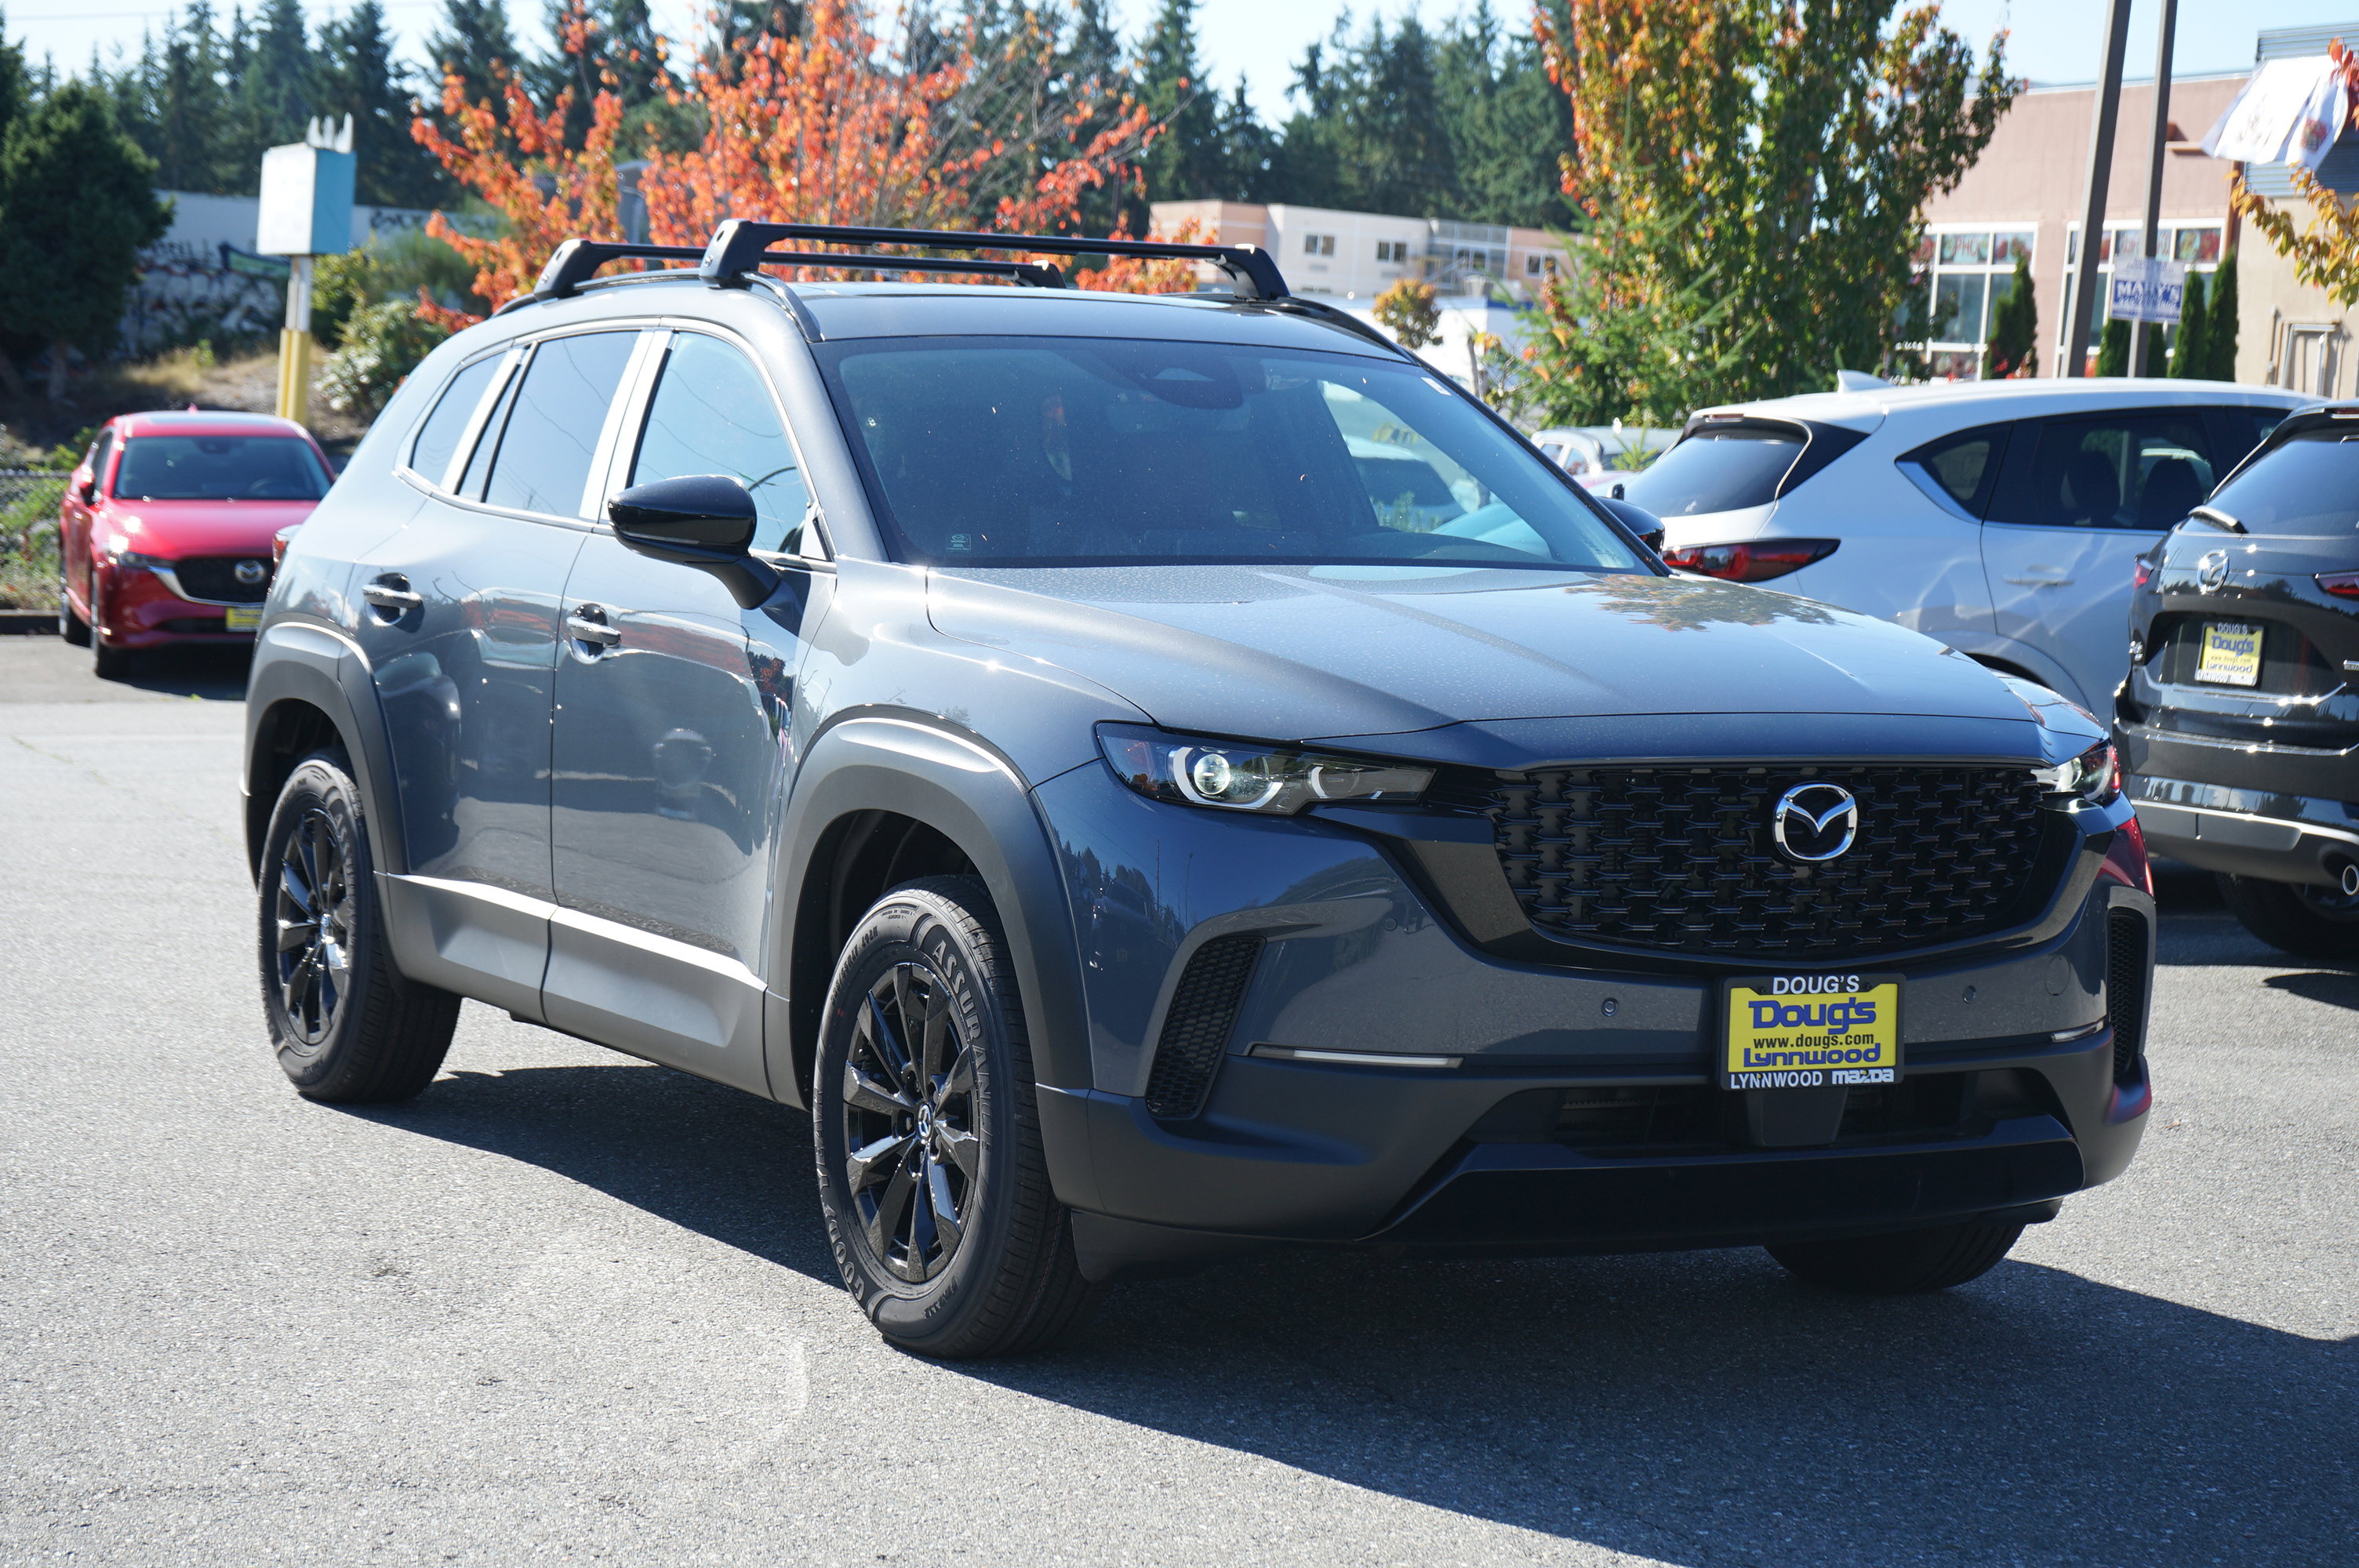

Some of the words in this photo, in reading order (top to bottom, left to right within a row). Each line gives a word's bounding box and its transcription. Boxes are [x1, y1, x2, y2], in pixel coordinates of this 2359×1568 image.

[2217, 622, 2248, 634] DOUG'S
[2211, 635, 2254, 657] Doug's
[2206, 660, 2253, 673] Lynnwood
[1772, 975, 1859, 995] DOUG'S
[1748, 996, 1877, 1035] Doug's
[932, 939, 992, 1156] ASSURANCE
[1754, 1033, 1874, 1049] www.dougs.com
[1743, 1043, 1881, 1067] Lynnwood
[1730, 1071, 1823, 1089] LYNNWOOD
